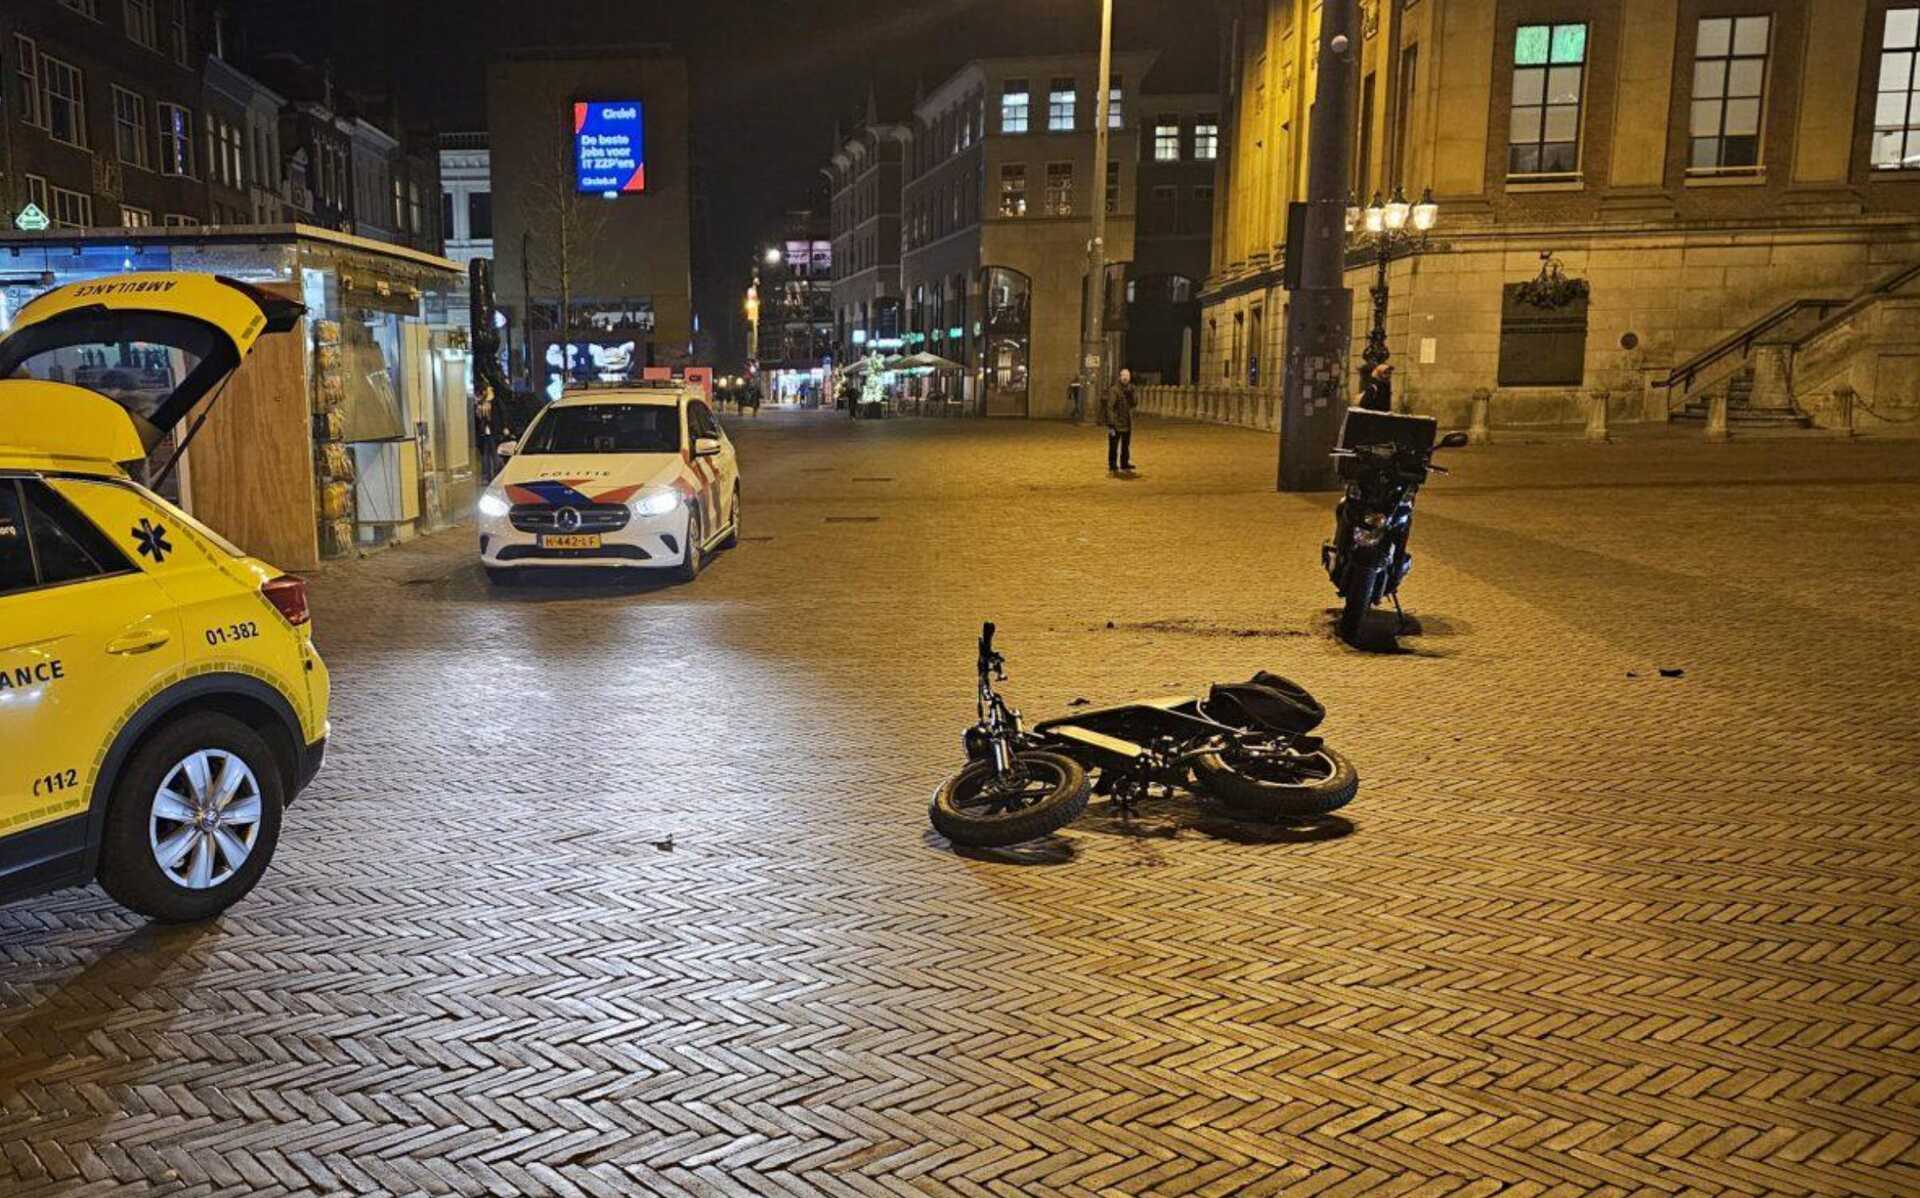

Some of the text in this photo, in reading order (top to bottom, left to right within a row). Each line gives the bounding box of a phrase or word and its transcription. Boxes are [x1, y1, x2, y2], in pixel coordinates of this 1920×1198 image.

[581, 134, 630, 146] De beste
[606, 147, 631, 157] voor
[73, 280, 177, 297] AMBULANCE
[205, 621, 260, 646] 01-382
